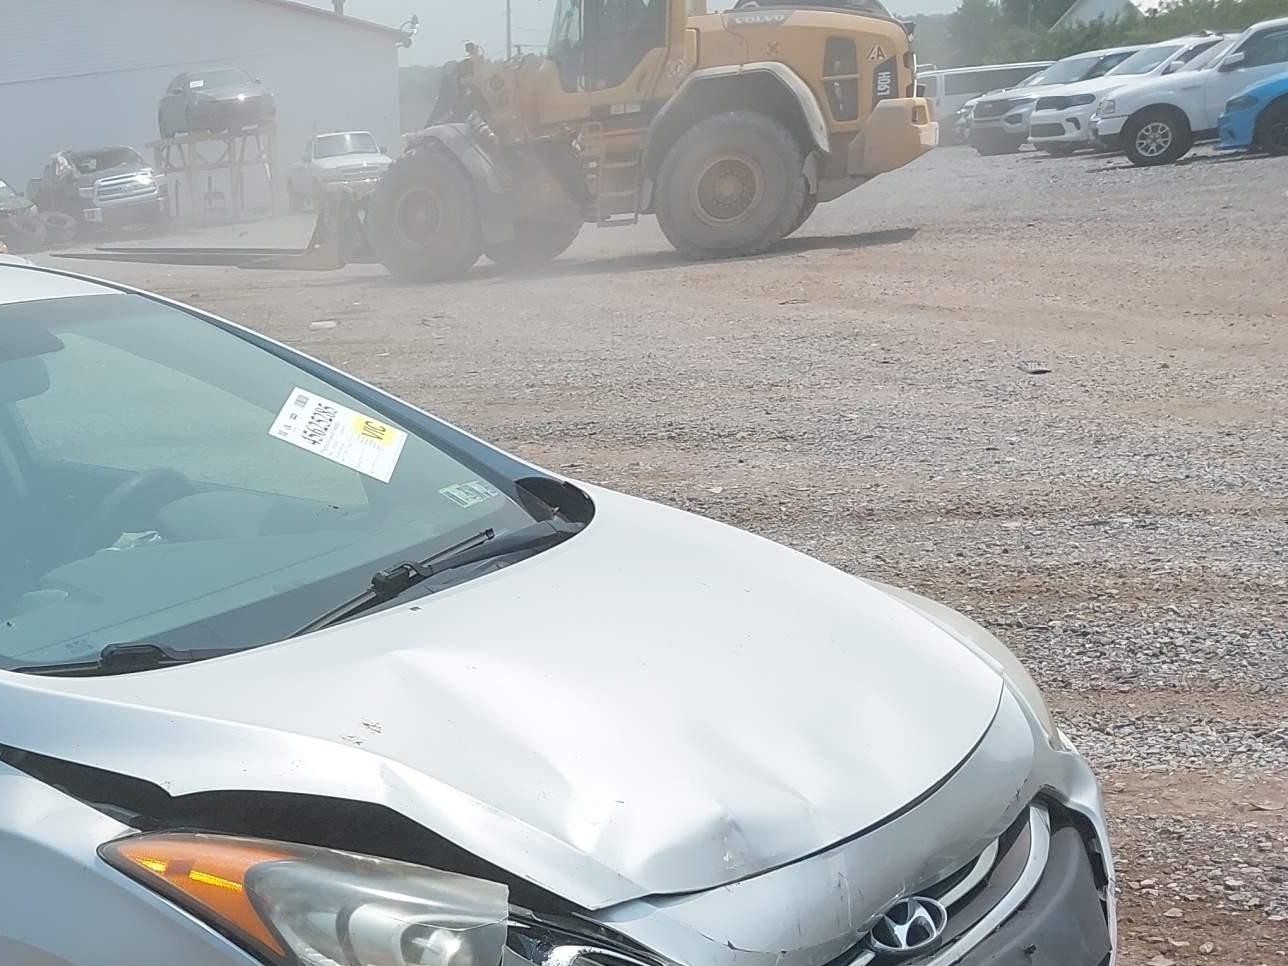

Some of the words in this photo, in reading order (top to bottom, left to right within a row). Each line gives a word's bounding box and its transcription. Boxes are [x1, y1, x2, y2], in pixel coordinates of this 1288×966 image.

[735, 14, 785, 25] VOLVO
[877, 71, 891, 96] L90H
[300, 402, 338, 445] 45625285
[360, 420, 387, 441] VIC
